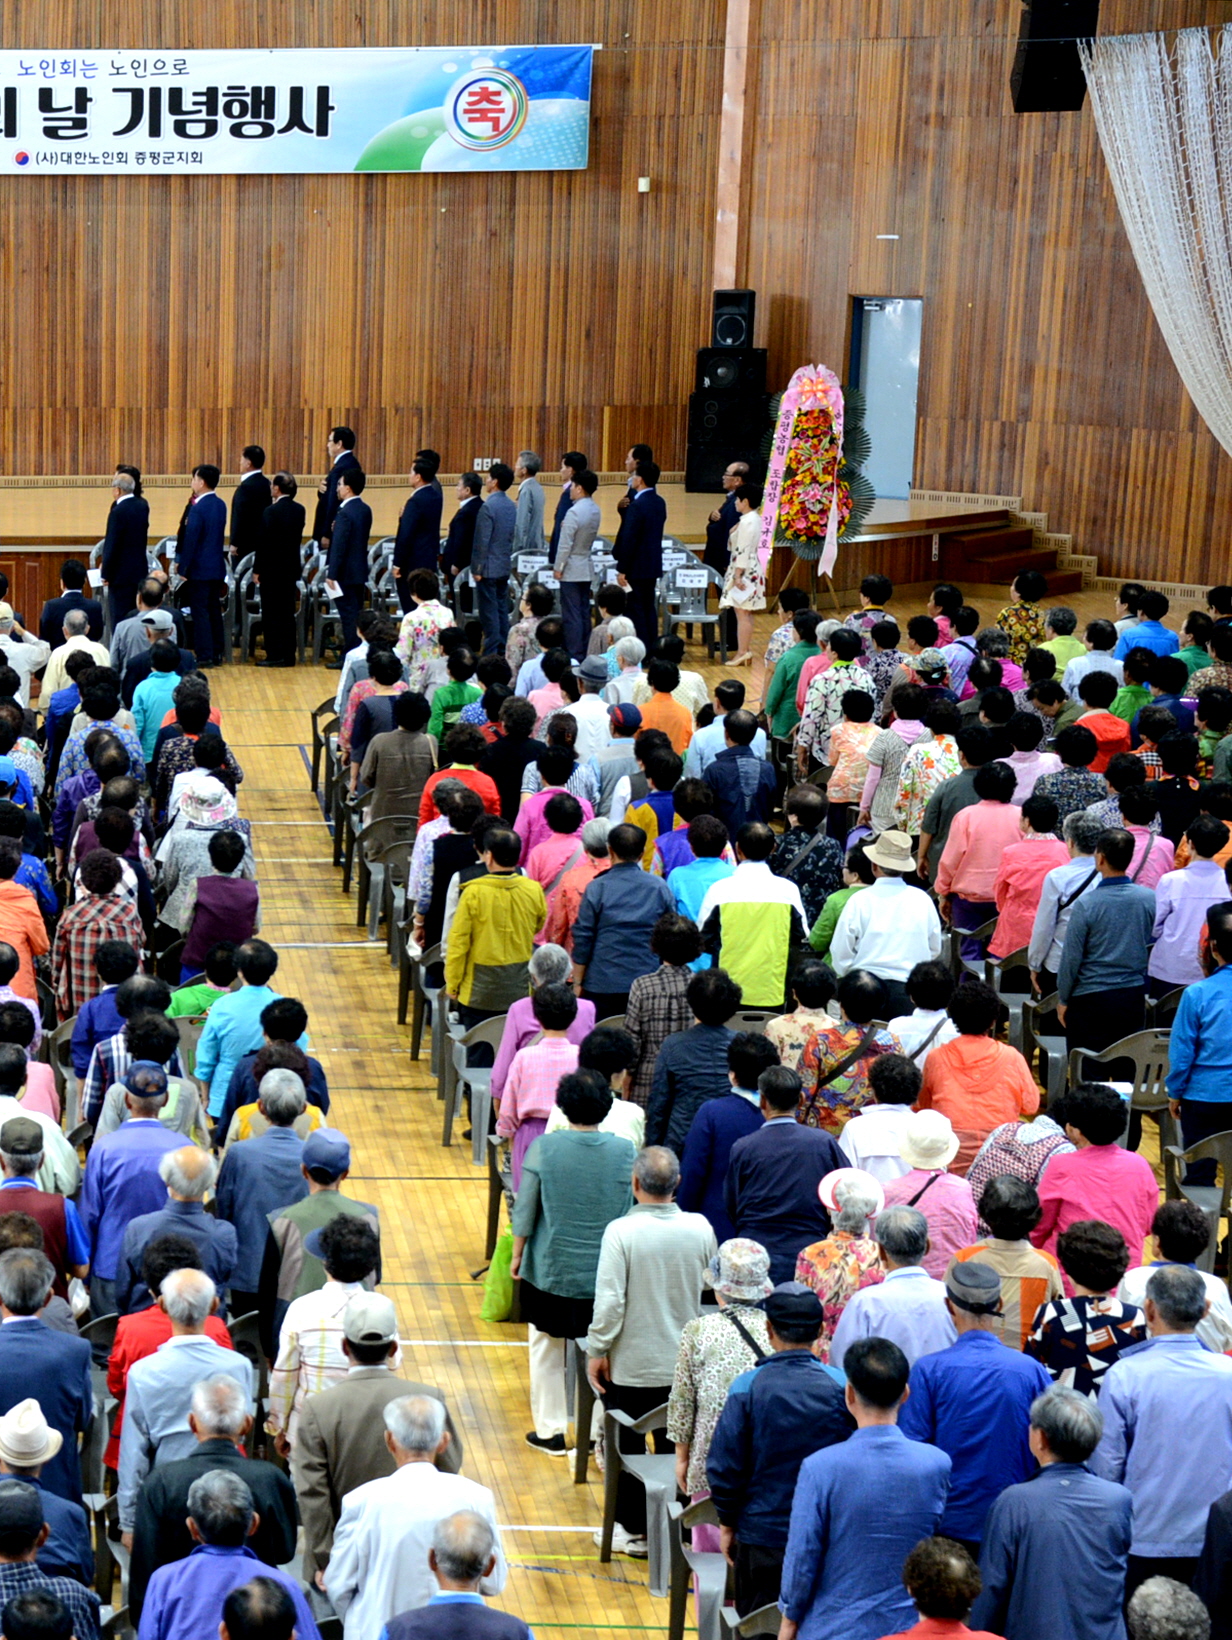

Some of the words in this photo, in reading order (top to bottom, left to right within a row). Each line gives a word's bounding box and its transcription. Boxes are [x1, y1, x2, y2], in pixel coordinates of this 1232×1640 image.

[17, 58, 99, 79] 노인회는
[108, 58, 190, 79] 노인으로
[37, 86, 94, 140] 날
[111, 85, 336, 140] 기념행사
[463, 86, 506, 132] 축
[35, 151, 129, 166] (사)대한노인회
[134, 151, 204, 166] 증평군지회
[776, 409, 794, 457] 증평농협
[767, 468, 782, 504] 조합장
